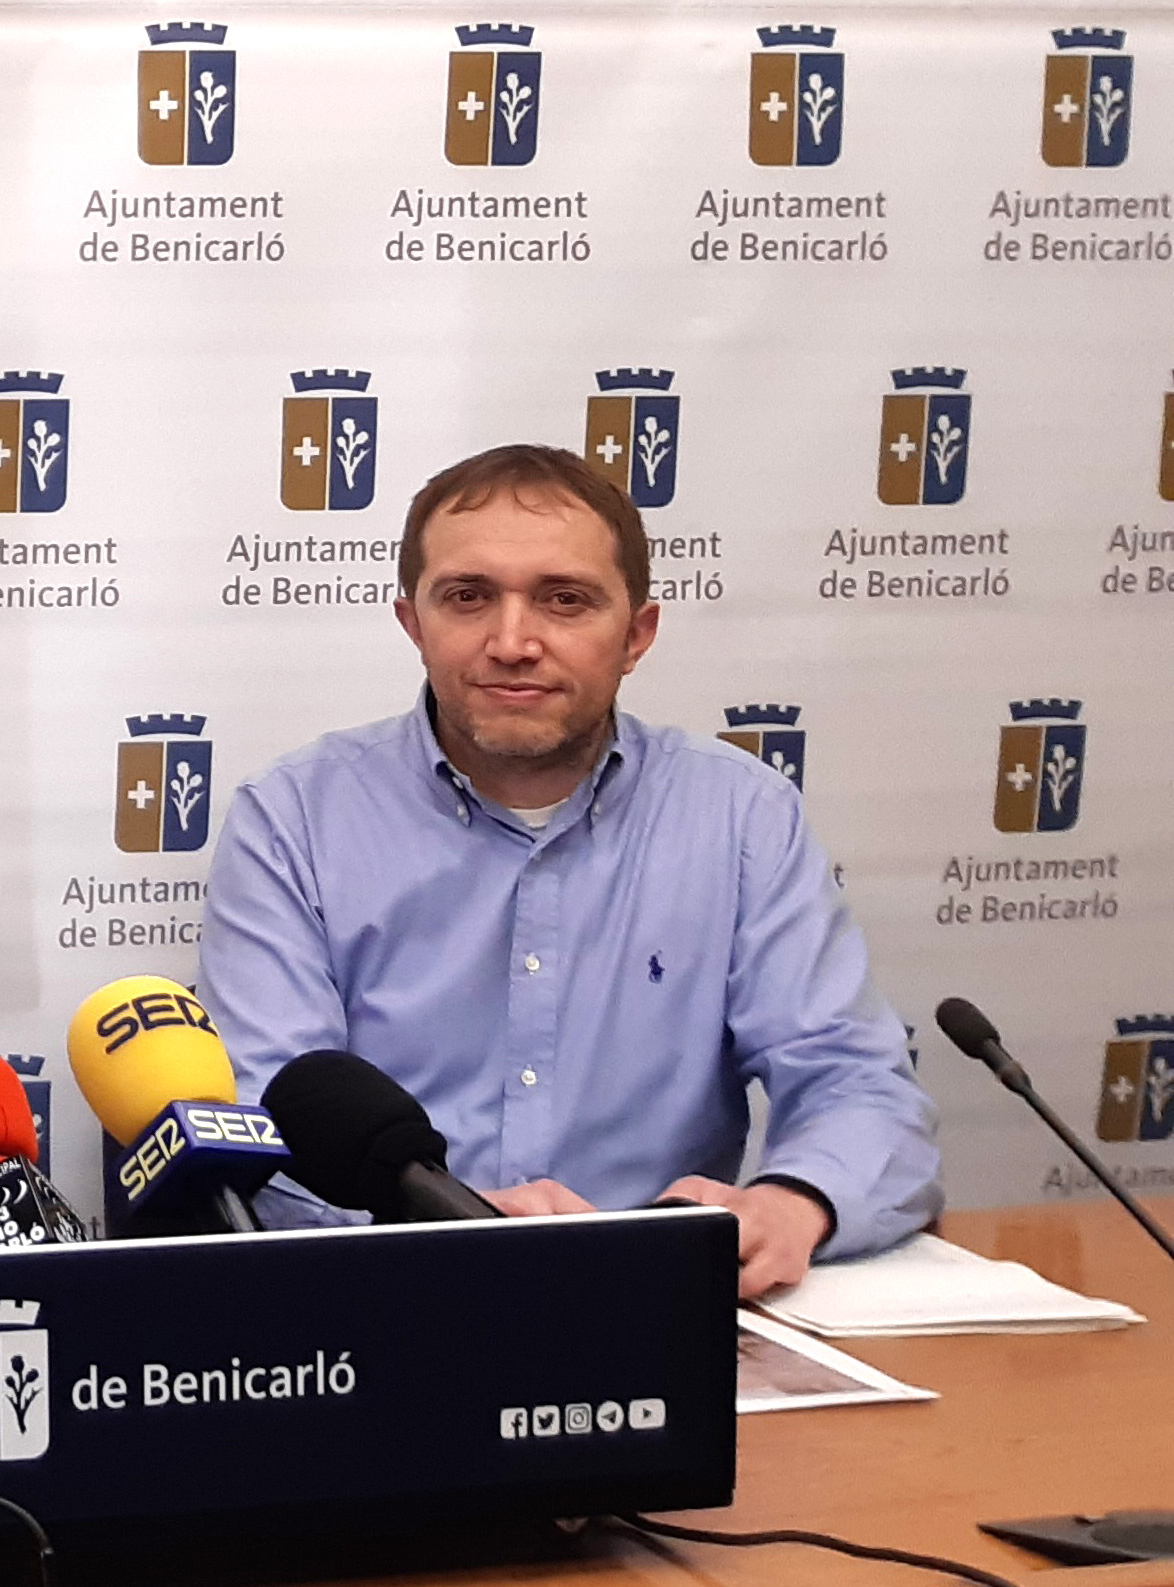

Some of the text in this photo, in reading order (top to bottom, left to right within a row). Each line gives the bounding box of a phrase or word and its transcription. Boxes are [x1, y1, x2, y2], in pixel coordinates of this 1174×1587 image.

[84, 190, 283, 227] Ajuntament
[391, 189, 587, 226] Ajuntament
[696, 189, 885, 226] Ajuntament
[990, 191, 1171, 227] Ajuntament
[80, 231, 284, 262] de Benicarló
[386, 231, 590, 261] de Benicarló
[691, 231, 887, 261] de Benicarló
[984, 232, 1172, 261] de Benicarló
[825, 528, 1008, 564] Ajuntament
[222, 576, 260, 605] de
[649, 570, 723, 600] carló
[820, 567, 1009, 598] de Benicarló
[1102, 566, 1137, 593] de
[943, 855, 1119, 890] Ajuntament
[62, 876, 208, 913] Ajuntam
[937, 890, 1118, 924] de Benicarló
[59, 918, 96, 948] de
[187, 1109, 284, 1145] SER
[119, 1117, 186, 1200] SER
[73, 1365, 126, 1410] de
[144, 1351, 355, 1405] Benicarló
